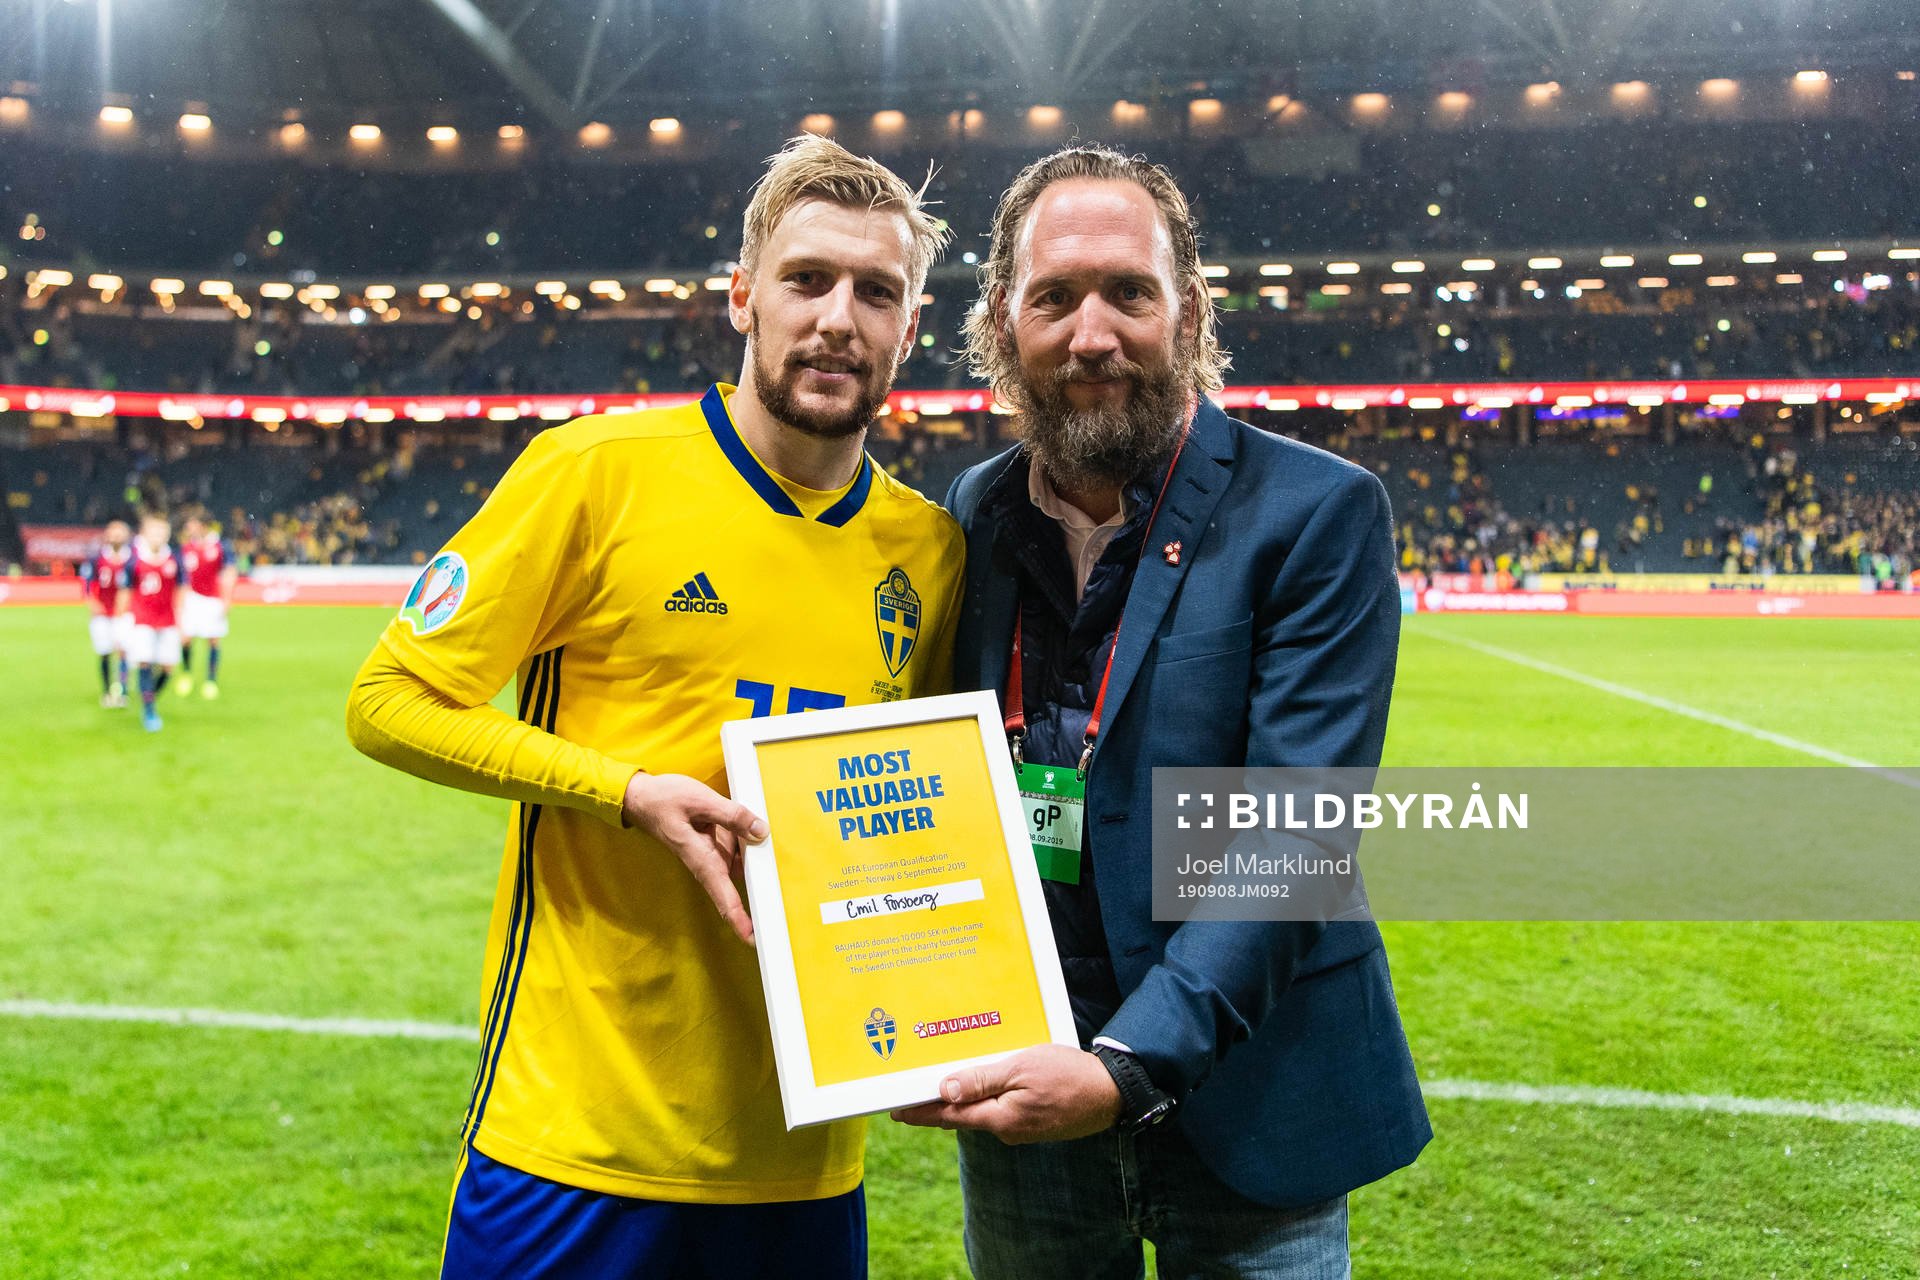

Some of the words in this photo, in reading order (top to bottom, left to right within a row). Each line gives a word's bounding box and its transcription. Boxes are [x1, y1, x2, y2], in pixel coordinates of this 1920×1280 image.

[664, 598, 728, 615] adidas
[884, 598, 914, 611] SVERIGE
[838, 750, 911, 780] MOST
[816, 775, 944, 812] VALUABLE
[839, 806, 936, 840] PLAYER
[1032, 804, 1061, 832] gP
[828, 878, 860, 890] Sweden
[866, 873, 895, 884] Norway
[897, 872, 902, 880] 8
[904, 866, 945, 880] September
[948, 862, 966, 872] 2019
[842, 866, 861, 875] UEFA
[863, 860, 898, 872] European
[900, 852, 948, 867] Qualification
[846, 898, 879, 918] Emil
[883, 892, 939, 912] Forsberg
[835, 940, 870, 952] BAUHAUS
[872, 936, 900, 946] donates
[927, 929, 940, 938] SEK
[942, 927, 948, 935] in
[950, 925, 962, 934] the
[963, 922, 984, 932] name
[845, 954, 853, 962] of
[855, 951, 867, 961] the
[868, 949, 890, 960] player
[901, 945, 912, 953] the
[914, 941, 938, 952] charity
[940, 935, 978, 947] foundation
[850, 966, 863, 974] The
[865, 960, 895, 972] Swedish
[896, 954, 932, 968] Childhood
[933, 951, 957, 961] Cancer
[959, 947, 977, 957] Fund
[928, 1012, 1000, 1035] BAUHAUS
